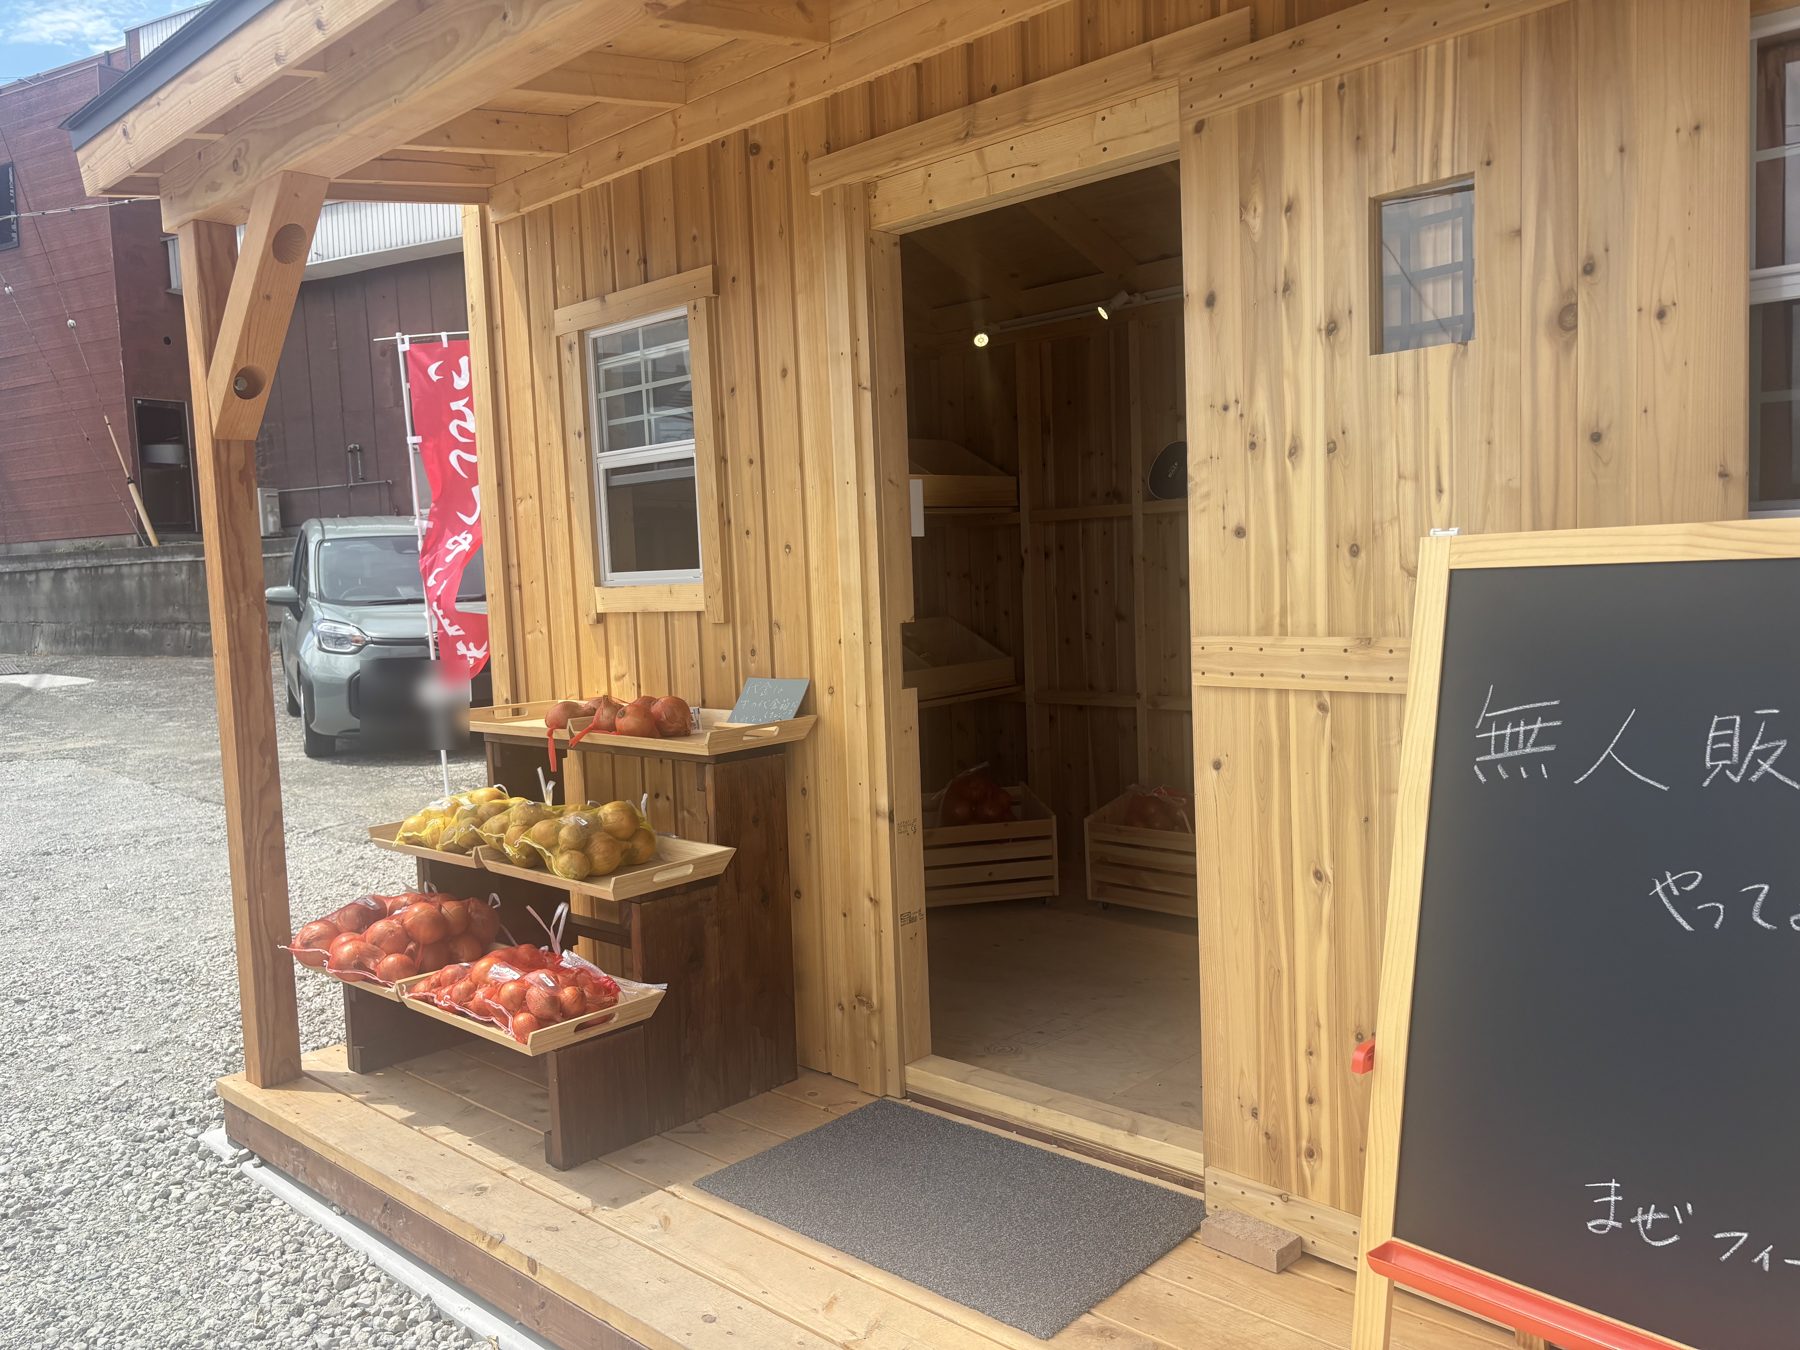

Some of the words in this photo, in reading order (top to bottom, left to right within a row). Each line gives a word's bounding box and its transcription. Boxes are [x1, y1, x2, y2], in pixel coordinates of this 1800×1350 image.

[1473, 684, 1800, 791] 無人販
[1649, 870, 1800, 932] やって
